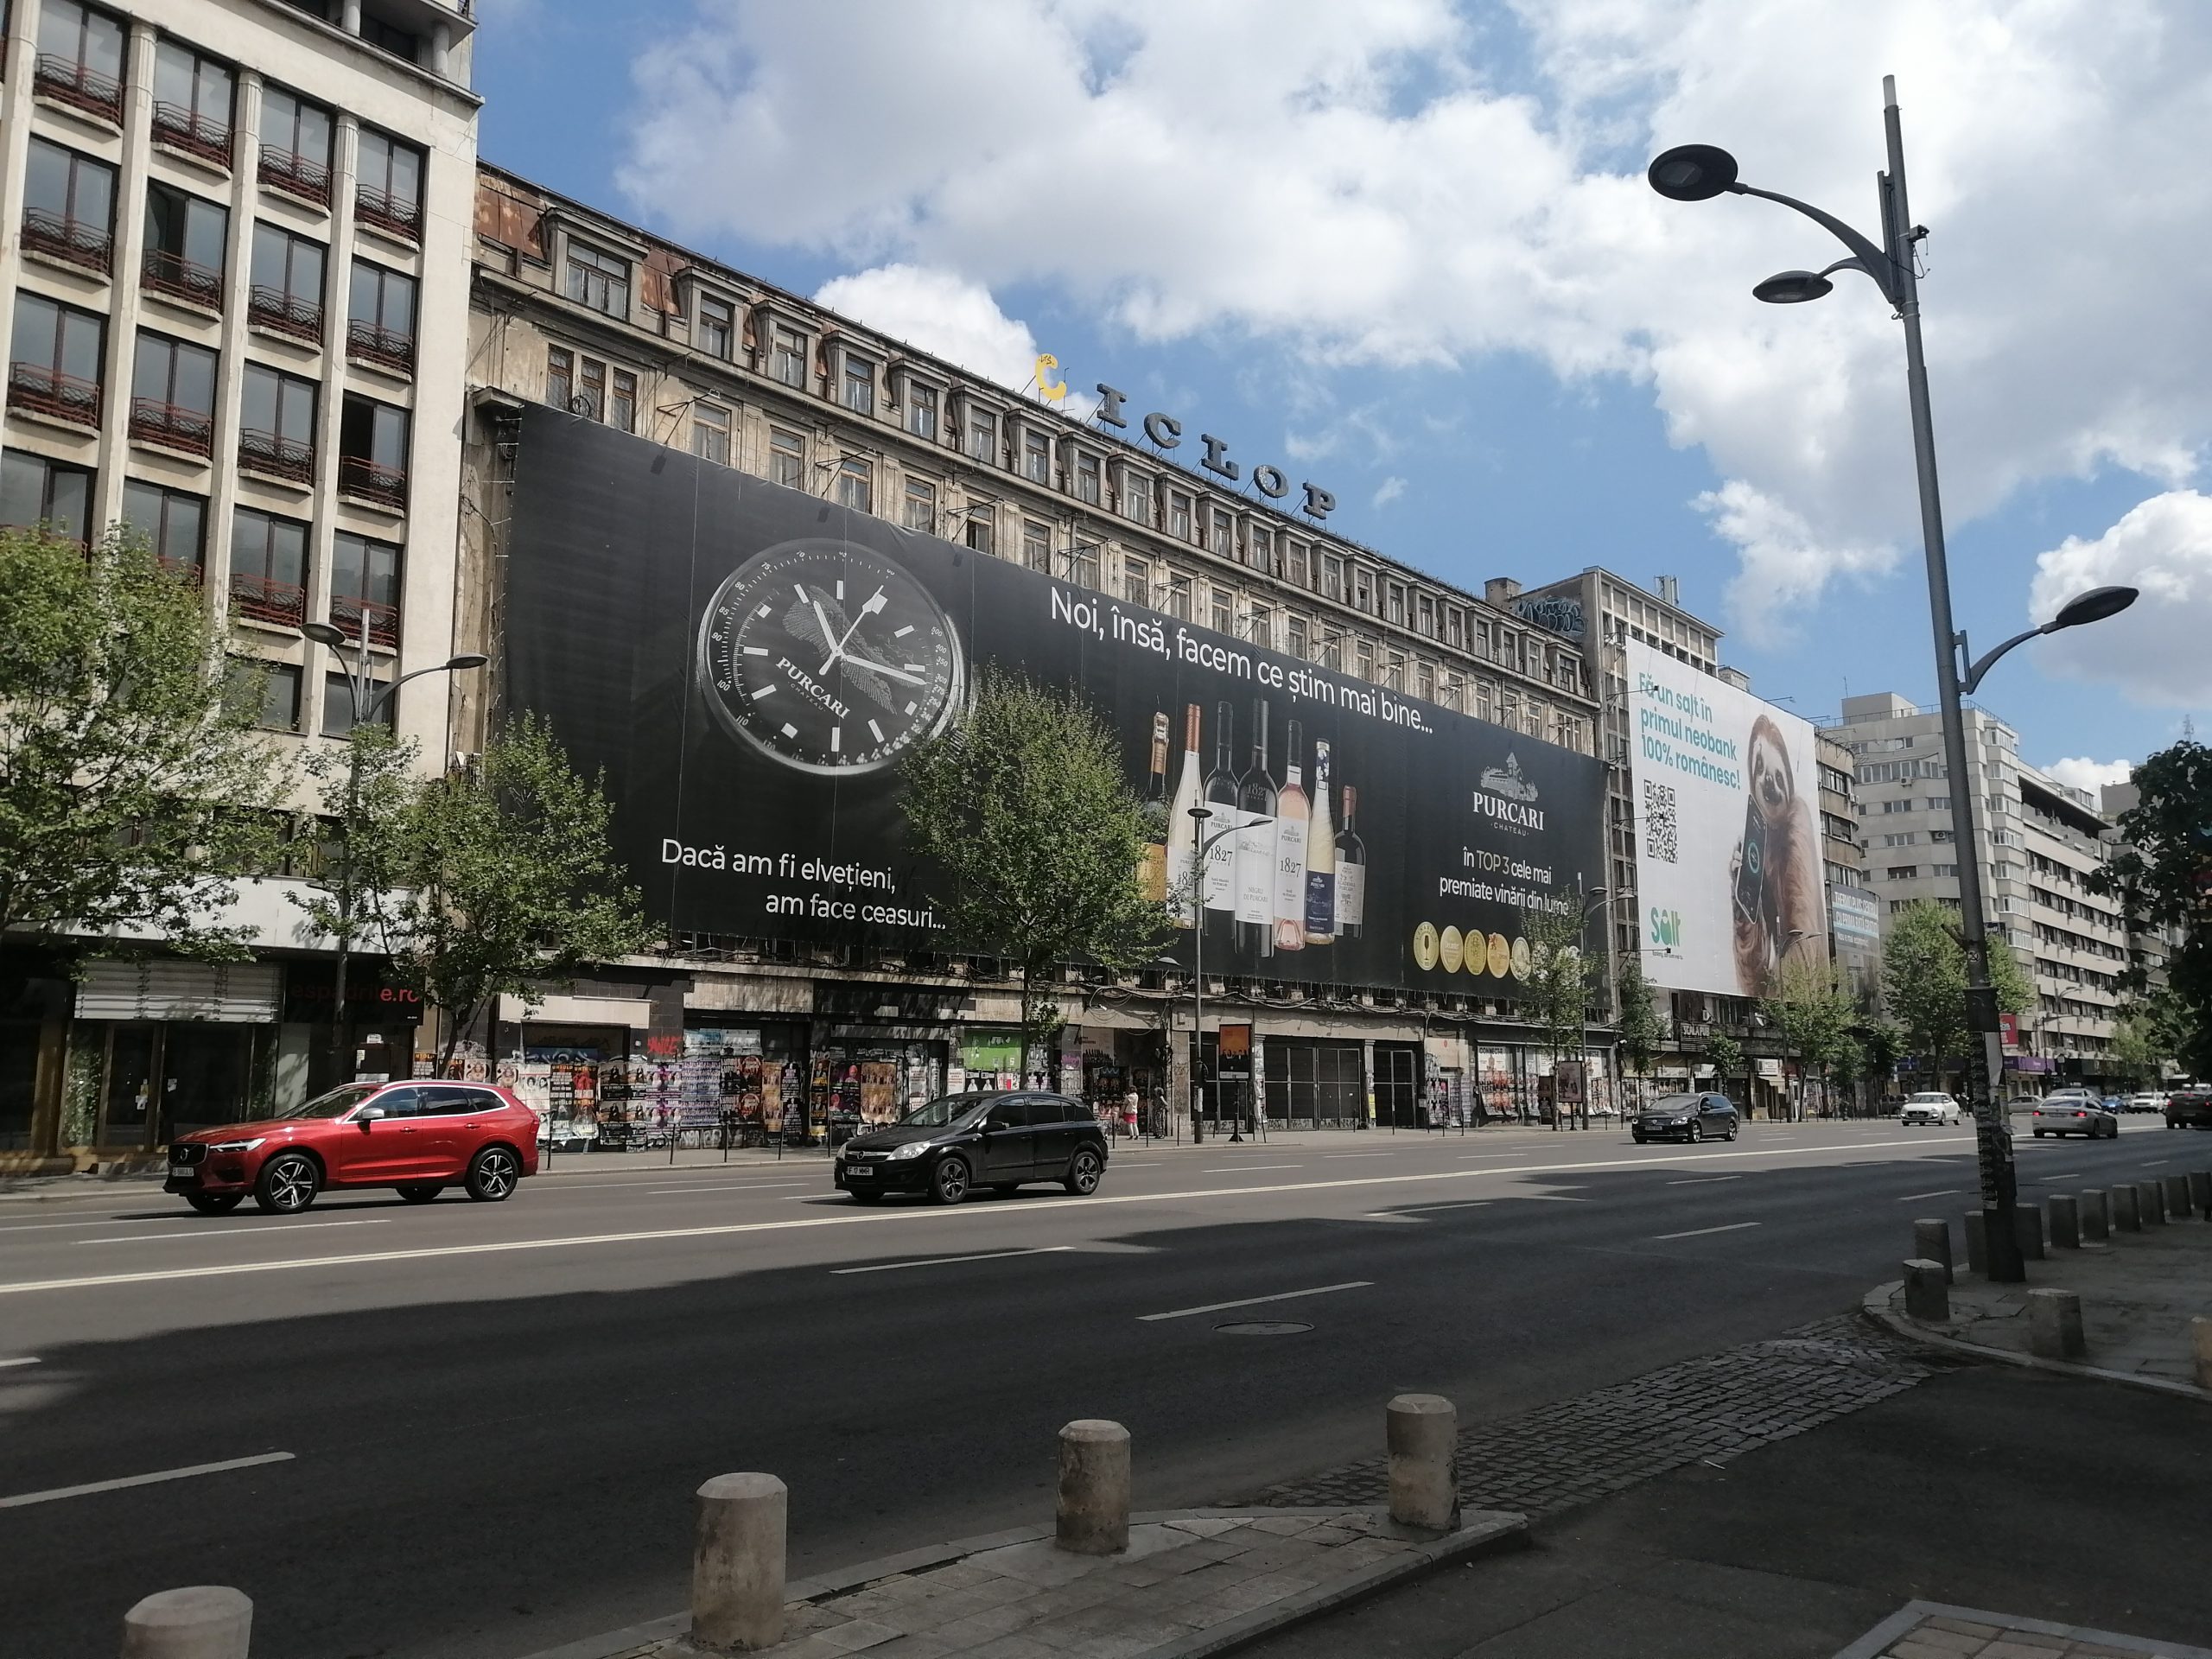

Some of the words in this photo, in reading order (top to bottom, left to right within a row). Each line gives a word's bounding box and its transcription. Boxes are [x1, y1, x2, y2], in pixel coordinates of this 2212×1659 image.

[734, 582, 746, 591] 80
[719, 606, 730, 616] 85
[711, 632, 722, 642] 90
[935, 644, 947, 654] 400
[936, 657, 949, 667] 350
[1051, 586, 1104, 641] Noi,
[1109, 606, 1172, 660] însă,
[1176, 630, 1253, 679] facem
[1256, 662, 1283, 687] ce
[1288, 669, 1335, 704] știm
[1340, 688, 1376, 715] mai
[1382, 693, 1433, 734] bine...
[716, 679, 730, 691] 100
[775, 657, 851, 719] PURCARI
[1657, 686, 1673, 707] un
[1676, 694, 1699, 717] salt
[1700, 697, 1713, 723] în
[1641, 707, 1682, 740] primul
[1685, 725, 1737, 761] neobank
[1642, 734, 1674, 766] 100%
[1676, 752, 1740, 790] românesc!
[1472, 791, 1545, 830] PURCARI
[1493, 822, 1527, 836] CHATEAU
[661, 838, 726, 869] Dacă
[733, 853, 772, 876] am
[779, 854, 796, 878] fi
[801, 858, 896, 894] elvețieni,
[1210, 845, 1233, 867] 1827
[1280, 857, 1301, 878] 1827
[1463, 846, 1474, 868] în
[1476, 849, 1501, 874] TOP
[1502, 855, 1510, 875] 3
[1511, 860, 1532, 880] cele
[1534, 866, 1552, 885] mai
[1439, 876, 1493, 901] premiate
[1495, 883, 1526, 907] vinării
[1528, 890, 1542, 911] din
[766, 893, 804, 916] am
[810, 893, 855, 920] face
[861, 906, 946, 930] ceasuri...
